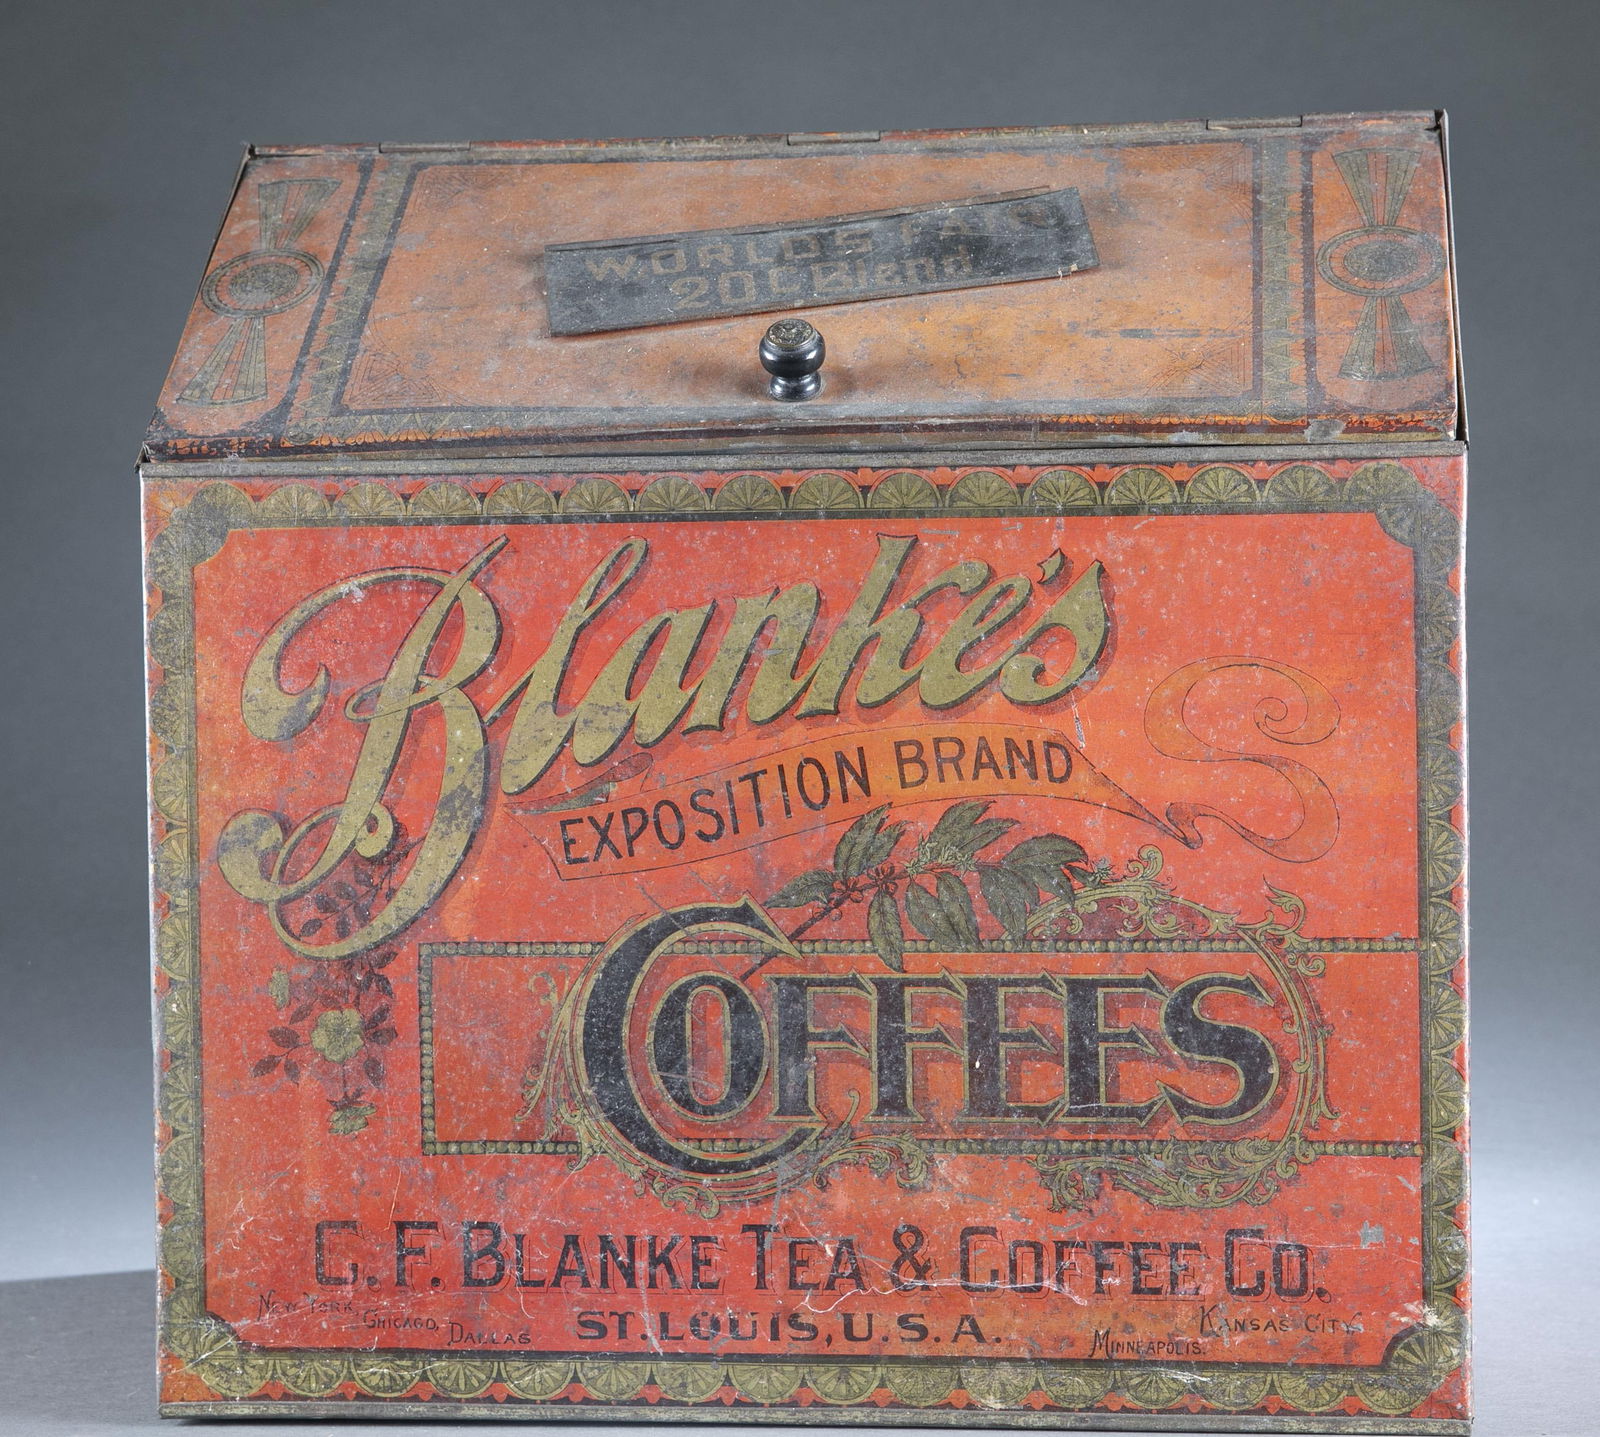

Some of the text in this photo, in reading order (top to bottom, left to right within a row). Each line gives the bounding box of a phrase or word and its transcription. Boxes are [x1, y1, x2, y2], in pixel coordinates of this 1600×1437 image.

[218, 533, 1112, 961] Blanke's
[560, 736, 1075, 866] EXPOSITION BRAND
[580, 897, 1283, 1182] COFFEES
[394, 1221, 442, 1288] F.
[461, 1221, 722, 1290] BLANKE
[741, 1223, 868, 1291] TEA
[890, 1224, 935, 1293] &
[959, 1225, 1202, 1296] COFFEE
[1223, 1228, 1332, 1297] CO.
[1199, 1303, 1289, 1338] KANSAS
